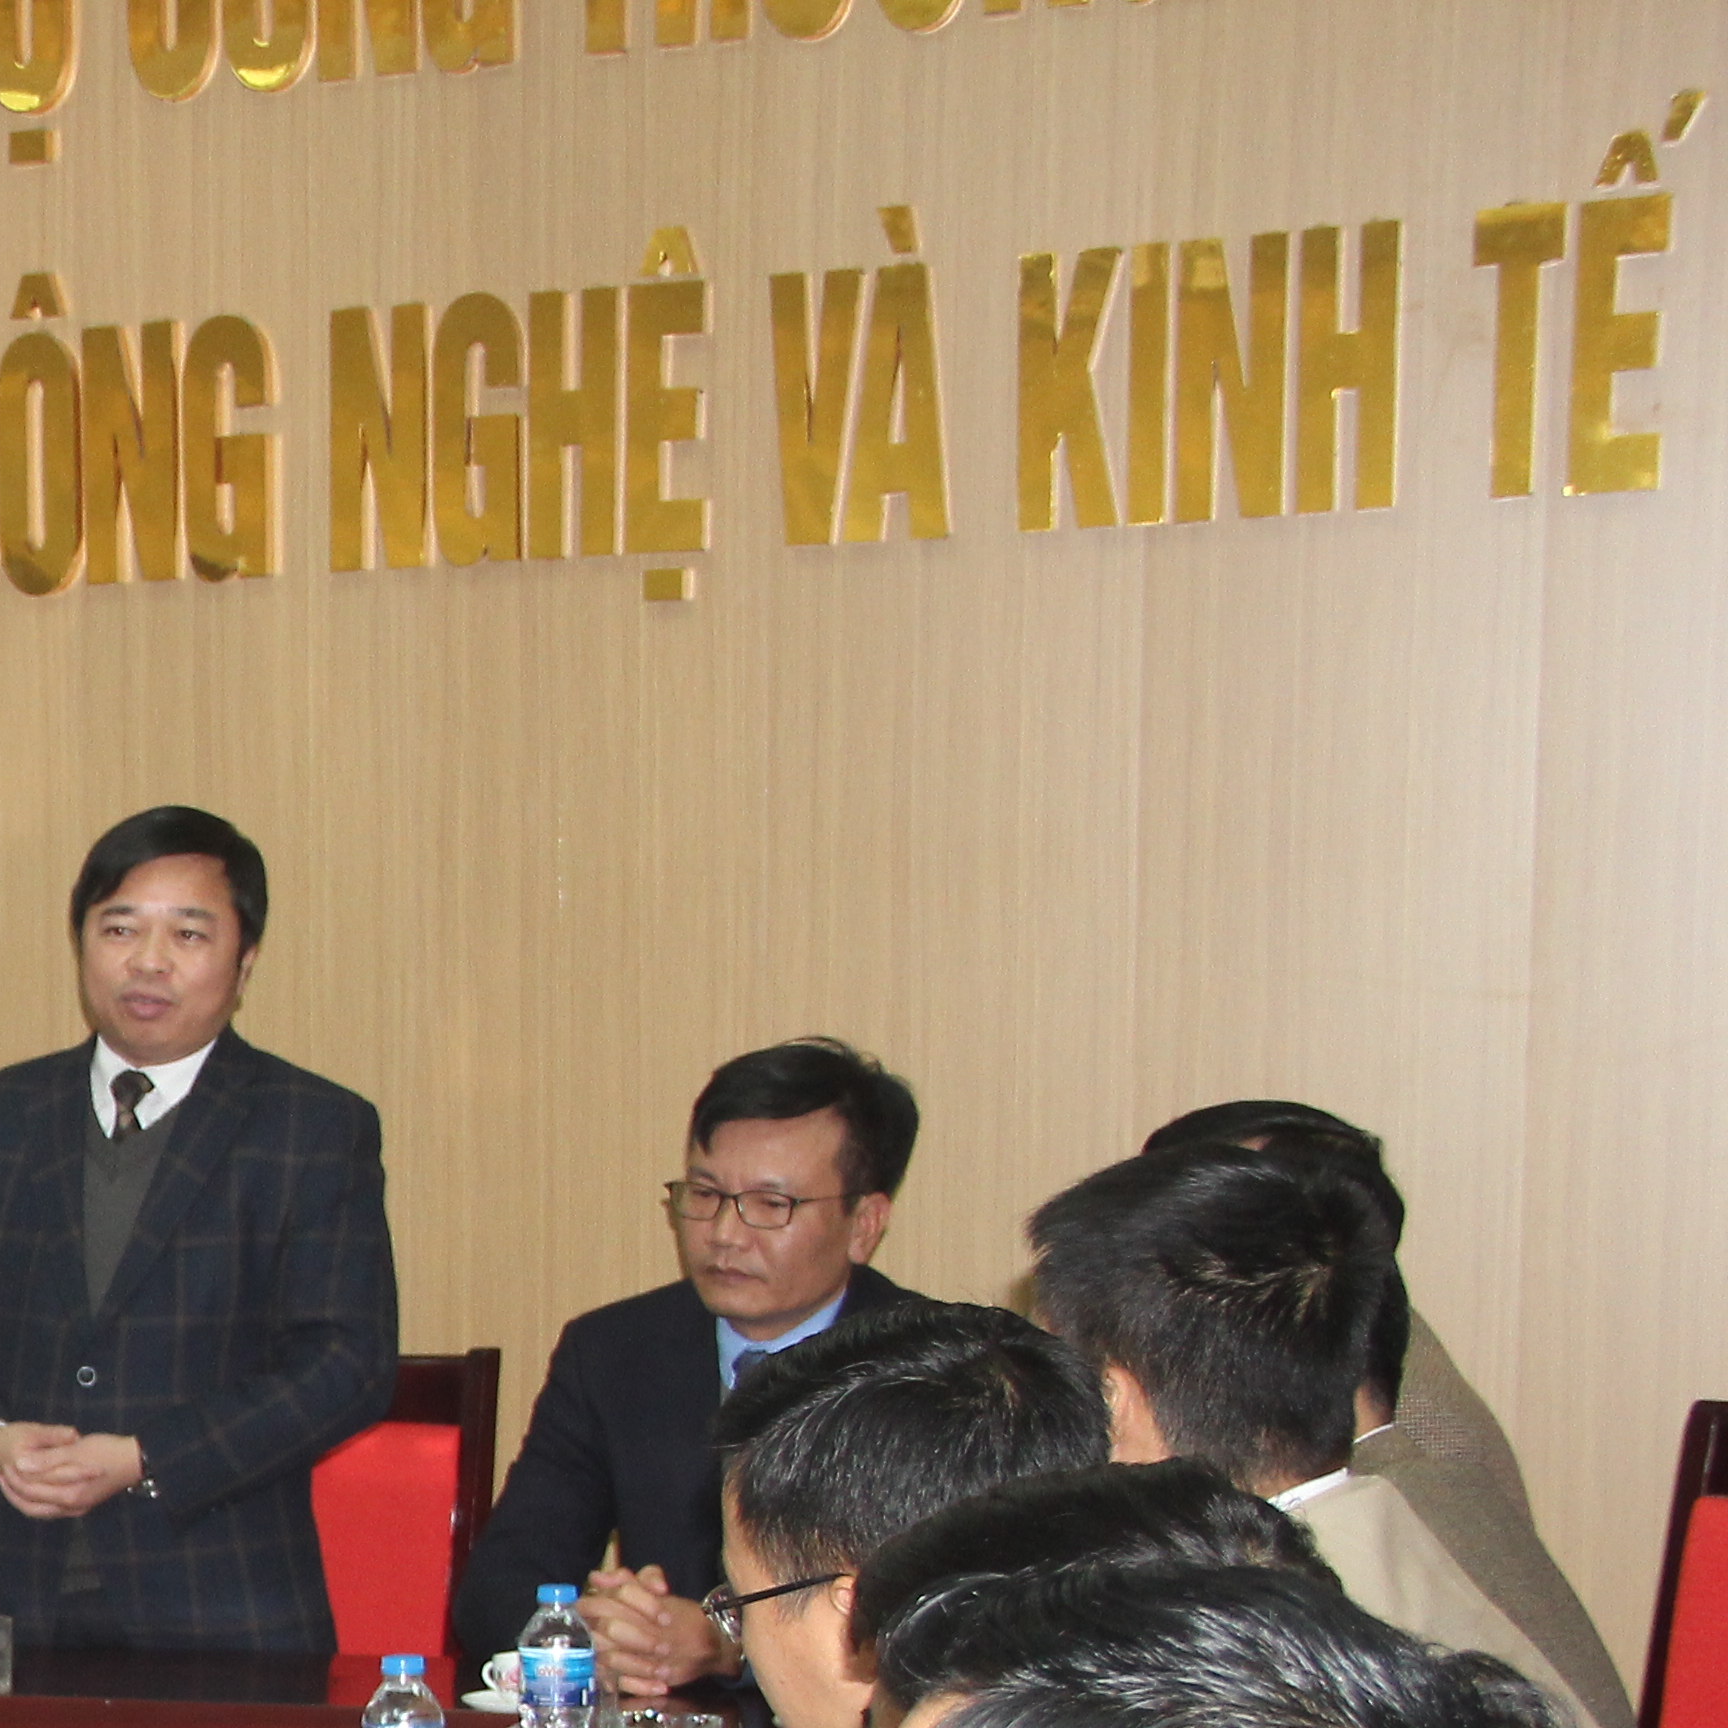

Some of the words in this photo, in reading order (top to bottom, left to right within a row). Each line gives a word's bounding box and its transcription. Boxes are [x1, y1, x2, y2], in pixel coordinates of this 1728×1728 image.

[328, 225, 712, 602] NGHỆ
[770, 204, 950, 548] VÀ
[1017, 218, 1402, 536] KINH
[1472, 87, 1707, 500] TẾ
